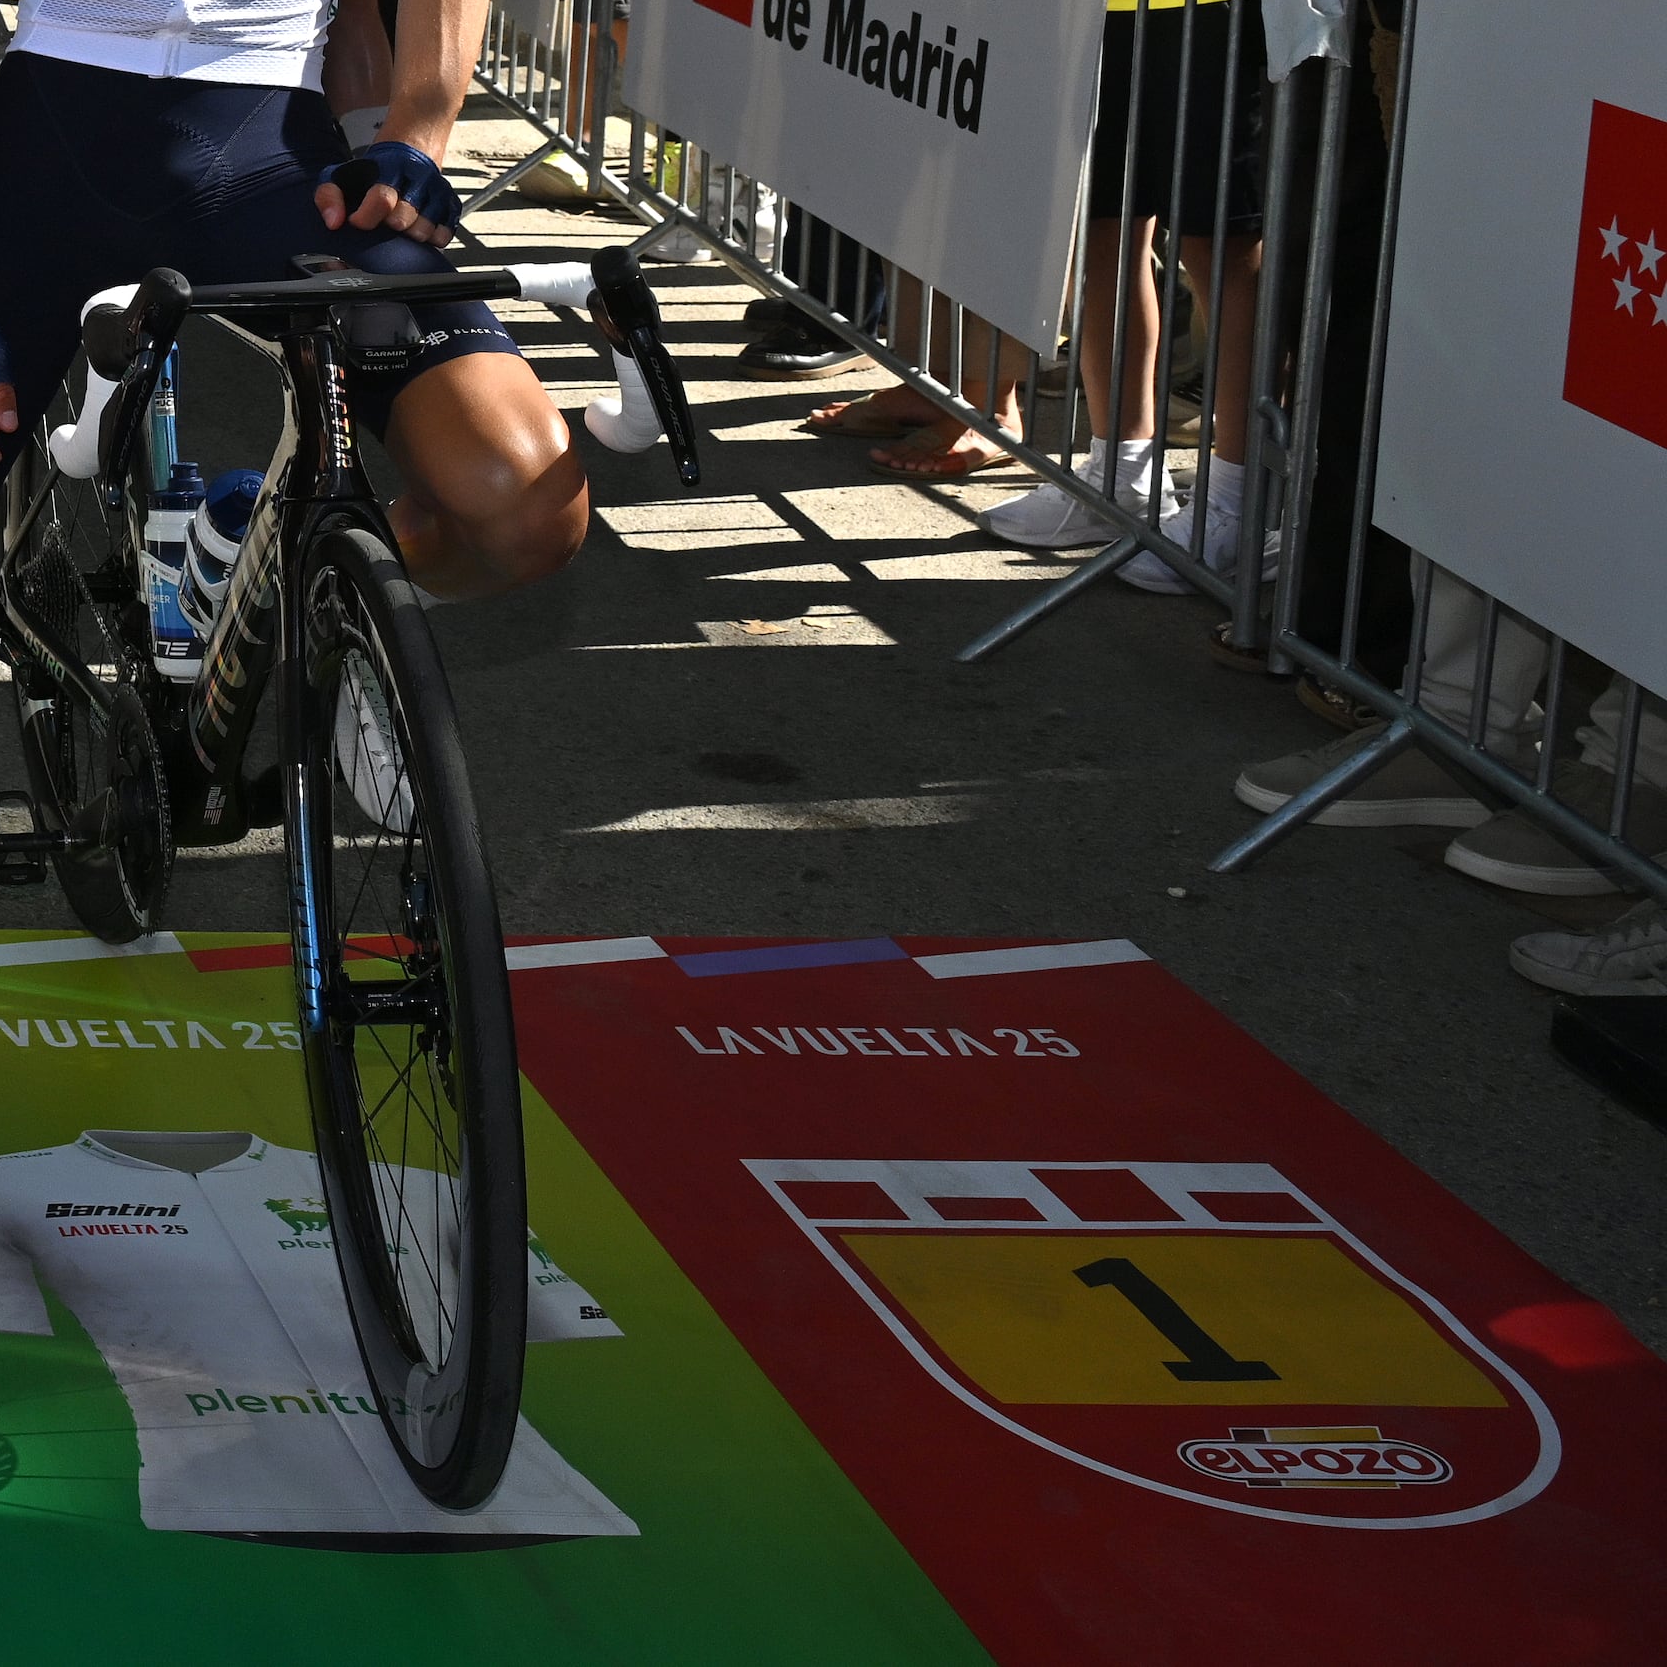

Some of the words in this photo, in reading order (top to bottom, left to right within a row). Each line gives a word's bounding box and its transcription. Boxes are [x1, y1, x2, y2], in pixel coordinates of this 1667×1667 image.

[365, 349, 407, 358] GARMIN
[23, 630, 66, 683] OSTRO
[5, 1018, 223, 1051] VUELTA
[230, 1021, 304, 1052] 25
[673, 1024, 765, 1056] LA
[769, 1025, 994, 1057] VUELTA
[993, 1028, 1081, 1059] 25
[45, 1202, 182, 1220] Santini
[58, 1225, 83, 1238] LA
[83, 1224, 160, 1237] VUELTA
[162, 1223, 190, 1235] 25
[1071, 1256, 1283, 1382] 1
